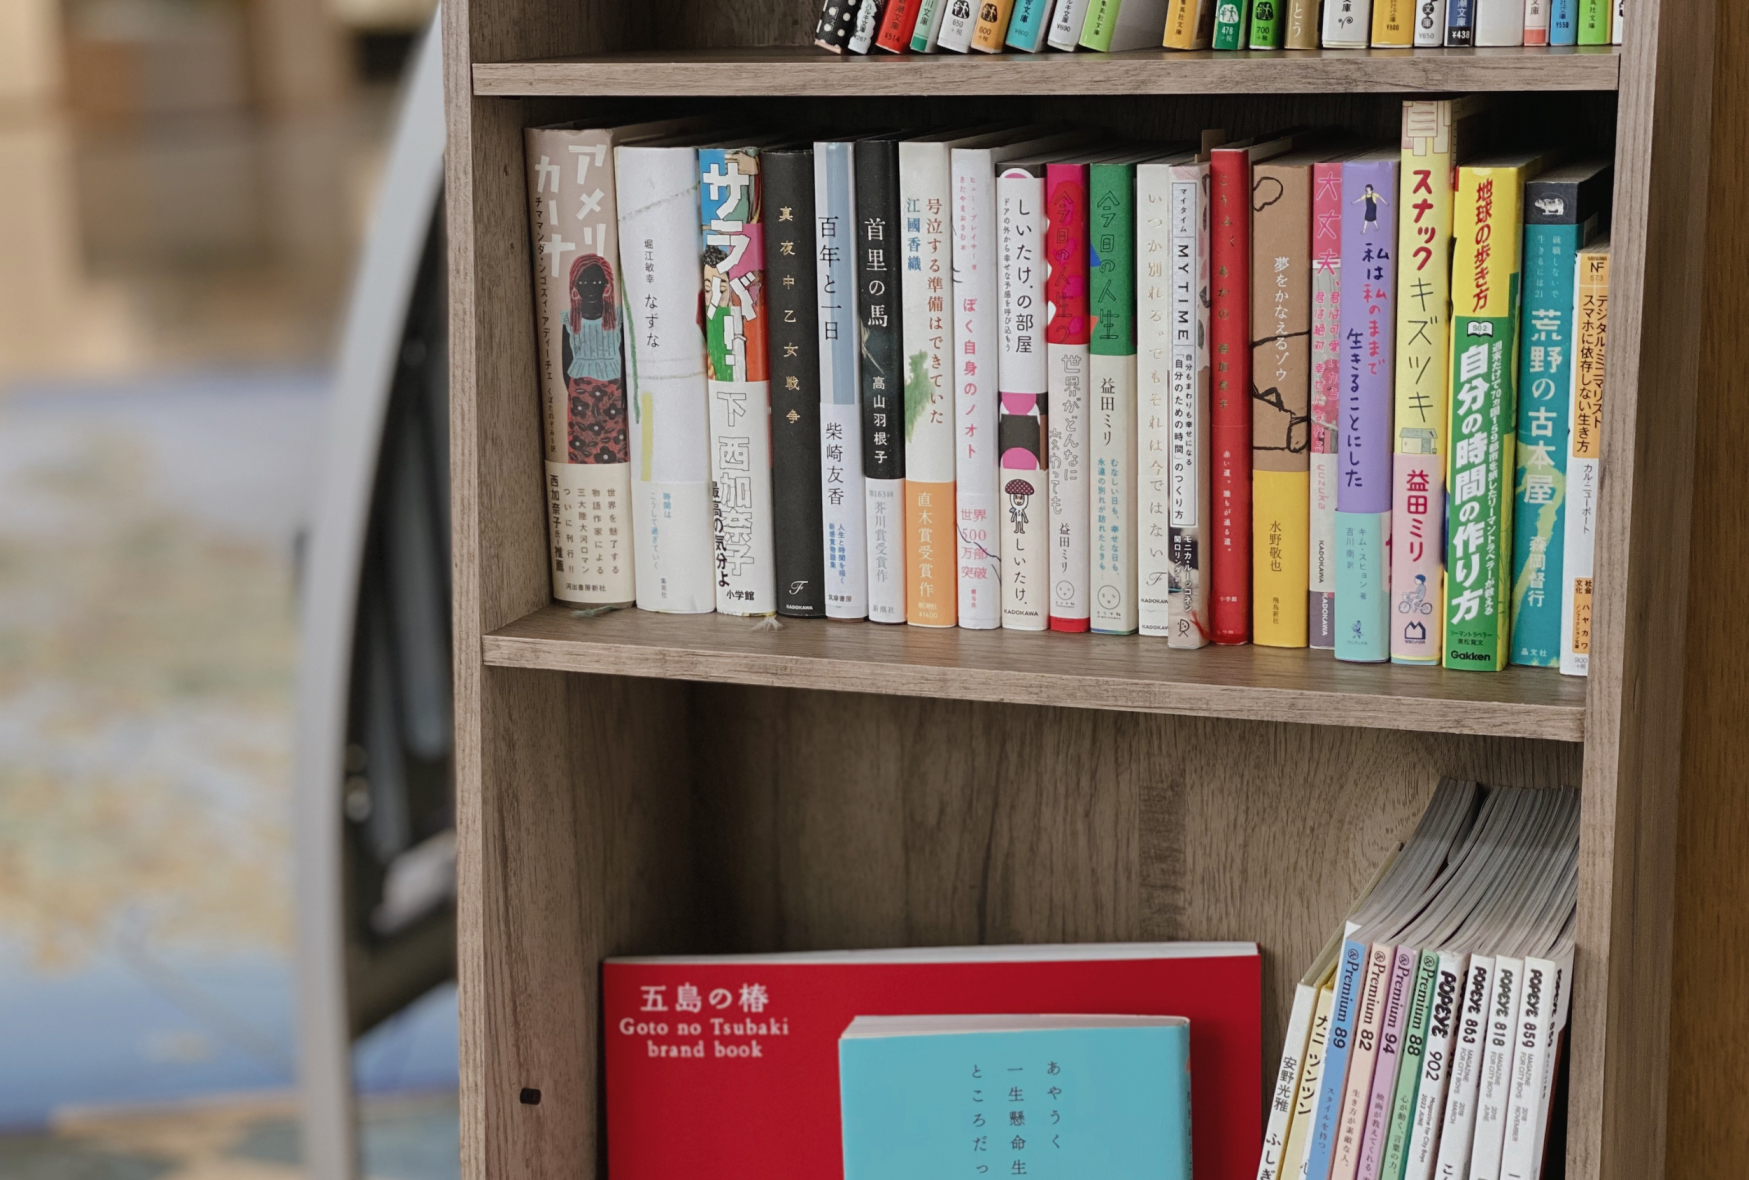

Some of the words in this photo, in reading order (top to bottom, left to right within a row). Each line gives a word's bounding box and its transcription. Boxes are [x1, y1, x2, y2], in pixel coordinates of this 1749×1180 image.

[952, 19, 964, 28] 650
[979, 26, 992, 36] 600
[1256, 26, 1270, 35] 700
[1451, 31, 1470, 40] ¥438
[535, 155, 576, 278] カーナ
[568, 144, 607, 256] アメリ
[1179, 188, 1187, 232] マイタイム
[644, 239, 654, 284] 堀江敏幸
[907, 197, 921, 271] 江國香織
[1472, 178, 1493, 313] 地球の歩き方
[818, 215, 842, 341] 百年と一日
[864, 218, 888, 328] 首里の馬
[1002, 198, 1011, 352] ドアの外から幸せな予感を呼び込もう
[1097, 190, 1120, 340] 今日の人生
[1217, 264, 1230, 320] あかの
[1590, 262, 1604, 273] NF
[645, 294, 660, 348] なずな
[778, 206, 801, 424] 真夜中乙女戦争
[926, 198, 944, 424] 号泣する準備はできていた
[1274, 256, 1290, 381] 夢をかなえるゾウ
[1362, 243, 1389, 376] 私は私のままで
[962, 298, 979, 459] ぼく自身のノオト
[1577, 294, 1595, 454] スマホに依存しない生き方
[716, 391, 746, 427] 下
[873, 377, 888, 464] 高山羽根子
[1060, 354, 1082, 481] 世界がどんなに
[1100, 378, 1116, 446] 益田ミリ
[1185, 354, 1193, 466] 自分もまわりも幸せになる
[1345, 328, 1363, 487] 生きることにした
[1524, 308, 1563, 505] 荒野の古本屋
[826, 422, 844, 505] 柴崎友香
[1174, 354, 1184, 520] 「自分のための時間」のつくり方
[1049, 428, 1062, 515] 変わっても
[1451, 337, 1488, 625] 自分の時間の作り方
[577, 488, 589, 573] 三大陸大河ロマン
[591, 489, 604, 574] 物語作家による
[607, 488, 619, 574] 世界を魅了する
[718, 436, 755, 577] 西加奈子
[961, 508, 987, 521] 世界
[962, 528, 987, 541] 500
[1406, 469, 1430, 562] 益田ミリ
[838, 524, 846, 584] 人生と時間を描く
[874, 501, 888, 583] 芥川賞受賞作
[918, 492, 933, 597] 直木賞受賞作
[961, 546, 987, 561] 万部
[1059, 523, 1071, 573] 益田ミリ
[1174, 535, 1182, 573] 関口リンダ
[1269, 520, 1282, 572] 水野敬也
[1358, 528, 1367, 589] キム・スヒョン
[565, 583, 606, 592] 河出書房新社
[726, 589, 755, 601] 小学館
[961, 566, 987, 579] 突破
[1184, 535, 1192, 612] モニカ・ルーッコネン
[1527, 535, 1546, 607] 森岡督行
[1575, 580, 1583, 594] 文化
[1584, 580, 1592, 594] 社会
[1521, 647, 1547, 657] 晶文社
[1581, 604, 1590, 649] ハヤカワ
[1451, 650, 1491, 662] Gakken
[640, 982, 769, 1013] 五島の椿
[1431, 970, 1456, 1038] POPEYE
[1468, 966, 1487, 1014] POPEYE
[1496, 969, 1513, 1017] POPEYE
[1525, 968, 1543, 1017] POPEYE
[619, 1017, 669, 1036] Goto
[677, 1023, 702, 1036] no
[710, 1017, 789, 1036] Tsubaki
[647, 1040, 705, 1058] brand
[714, 1040, 763, 1058] book
[1333, 1026, 1347, 1049] 89
[1359, 1029, 1374, 1052] 82
[1383, 1032, 1397, 1055] 94
[1407, 1034, 1422, 1057] 88
[1463, 1018, 1478, 1044] 863
[1492, 1022, 1507, 1047] 818
[1522, 1022, 1537, 1048] 859
[1274, 1056, 1297, 1113] 安野光雅
[1425, 1050, 1442, 1081] 902
[1463, 1050, 1473, 1082] MAGAZINE
[972, 1064, 989, 1174] ところだっ
[1007, 1067, 1027, 1175] 一生懸命生
[1047, 1061, 1062, 1149] あやうく
